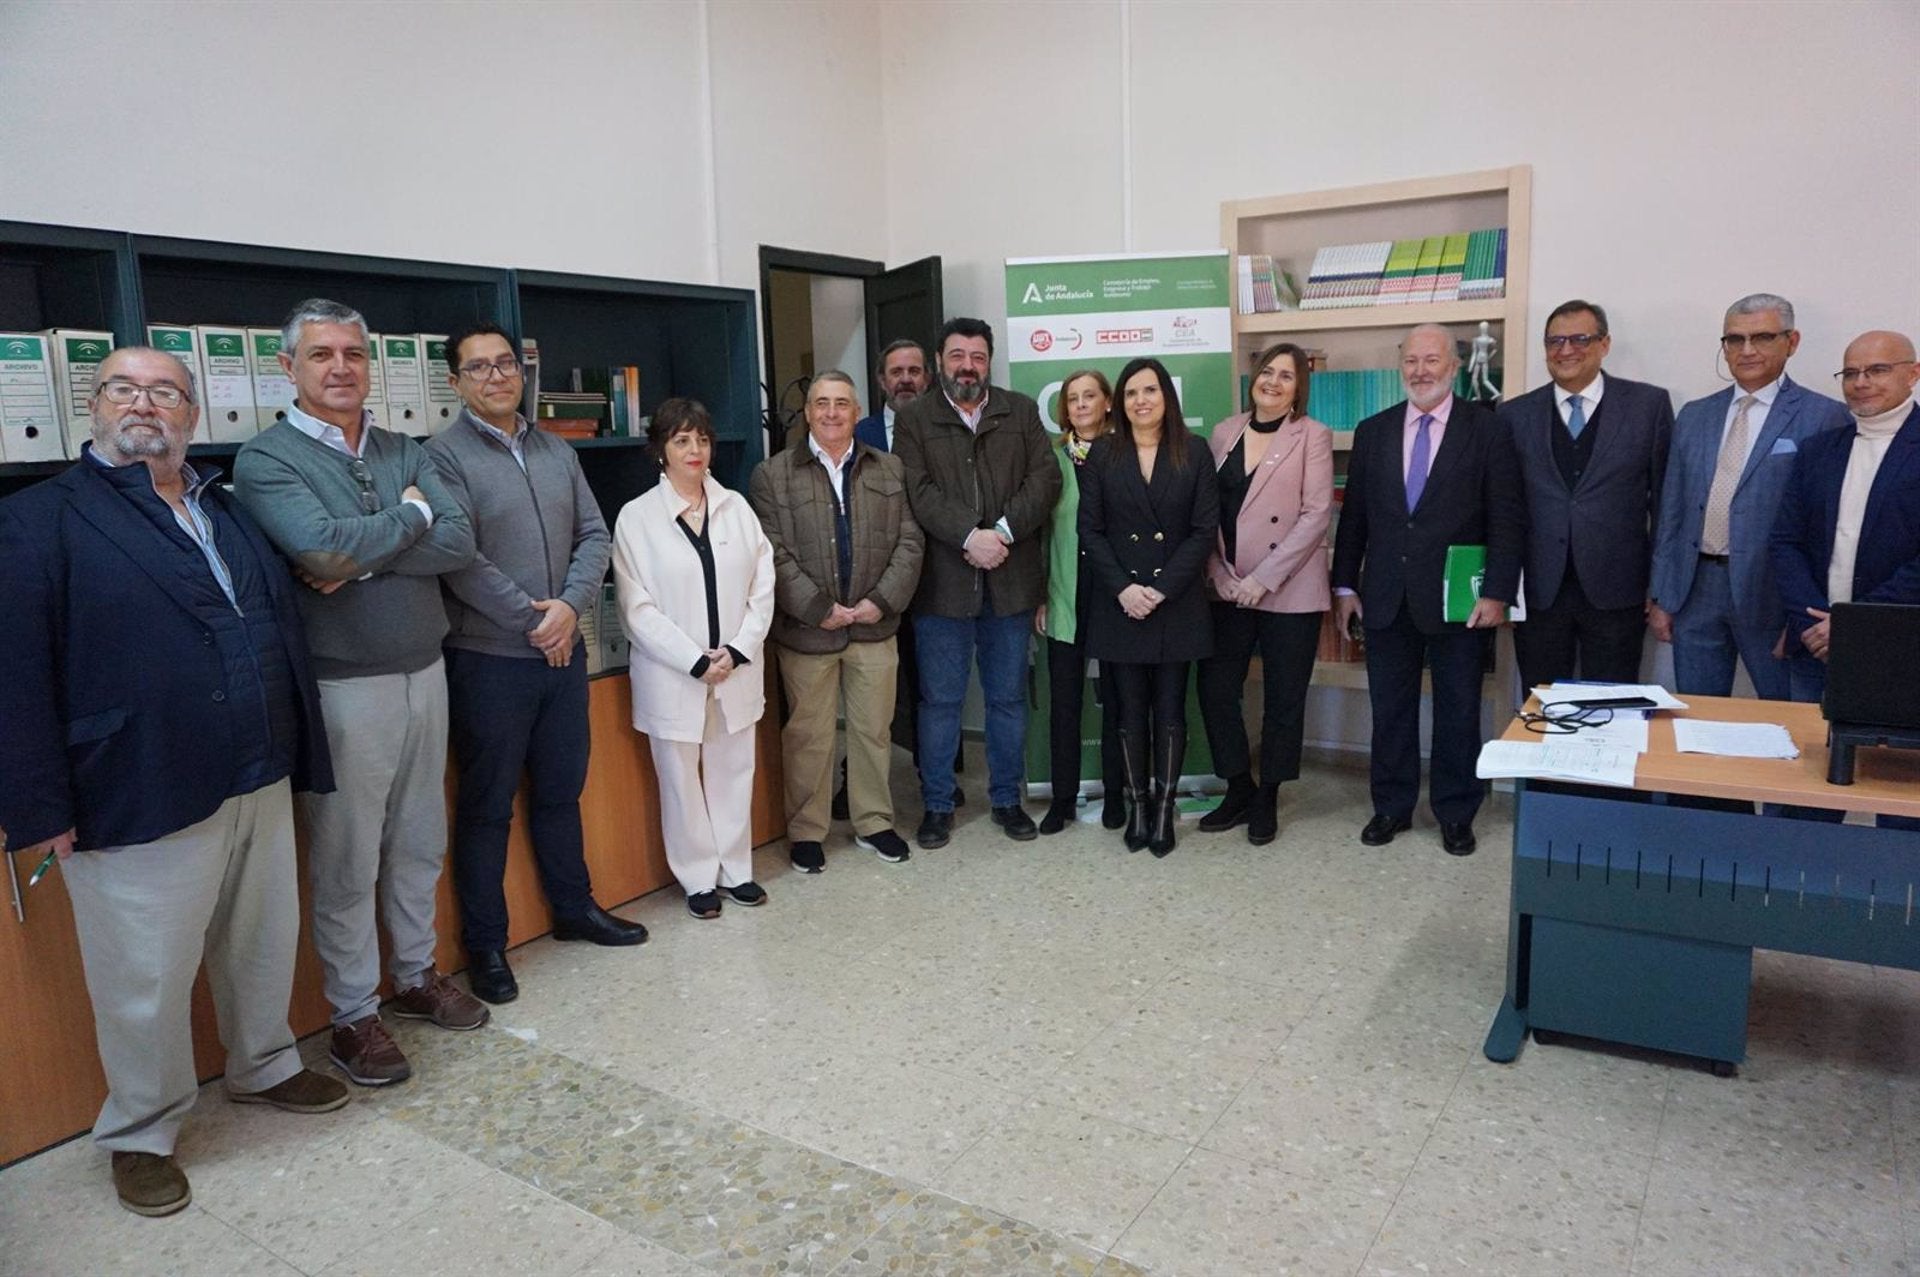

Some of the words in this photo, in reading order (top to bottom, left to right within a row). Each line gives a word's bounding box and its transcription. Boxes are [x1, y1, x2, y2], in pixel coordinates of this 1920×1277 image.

[1045, 283, 1067, 293] Junta
[1044, 292, 1055, 301] de
[1056, 289, 1093, 300] Andalucía
